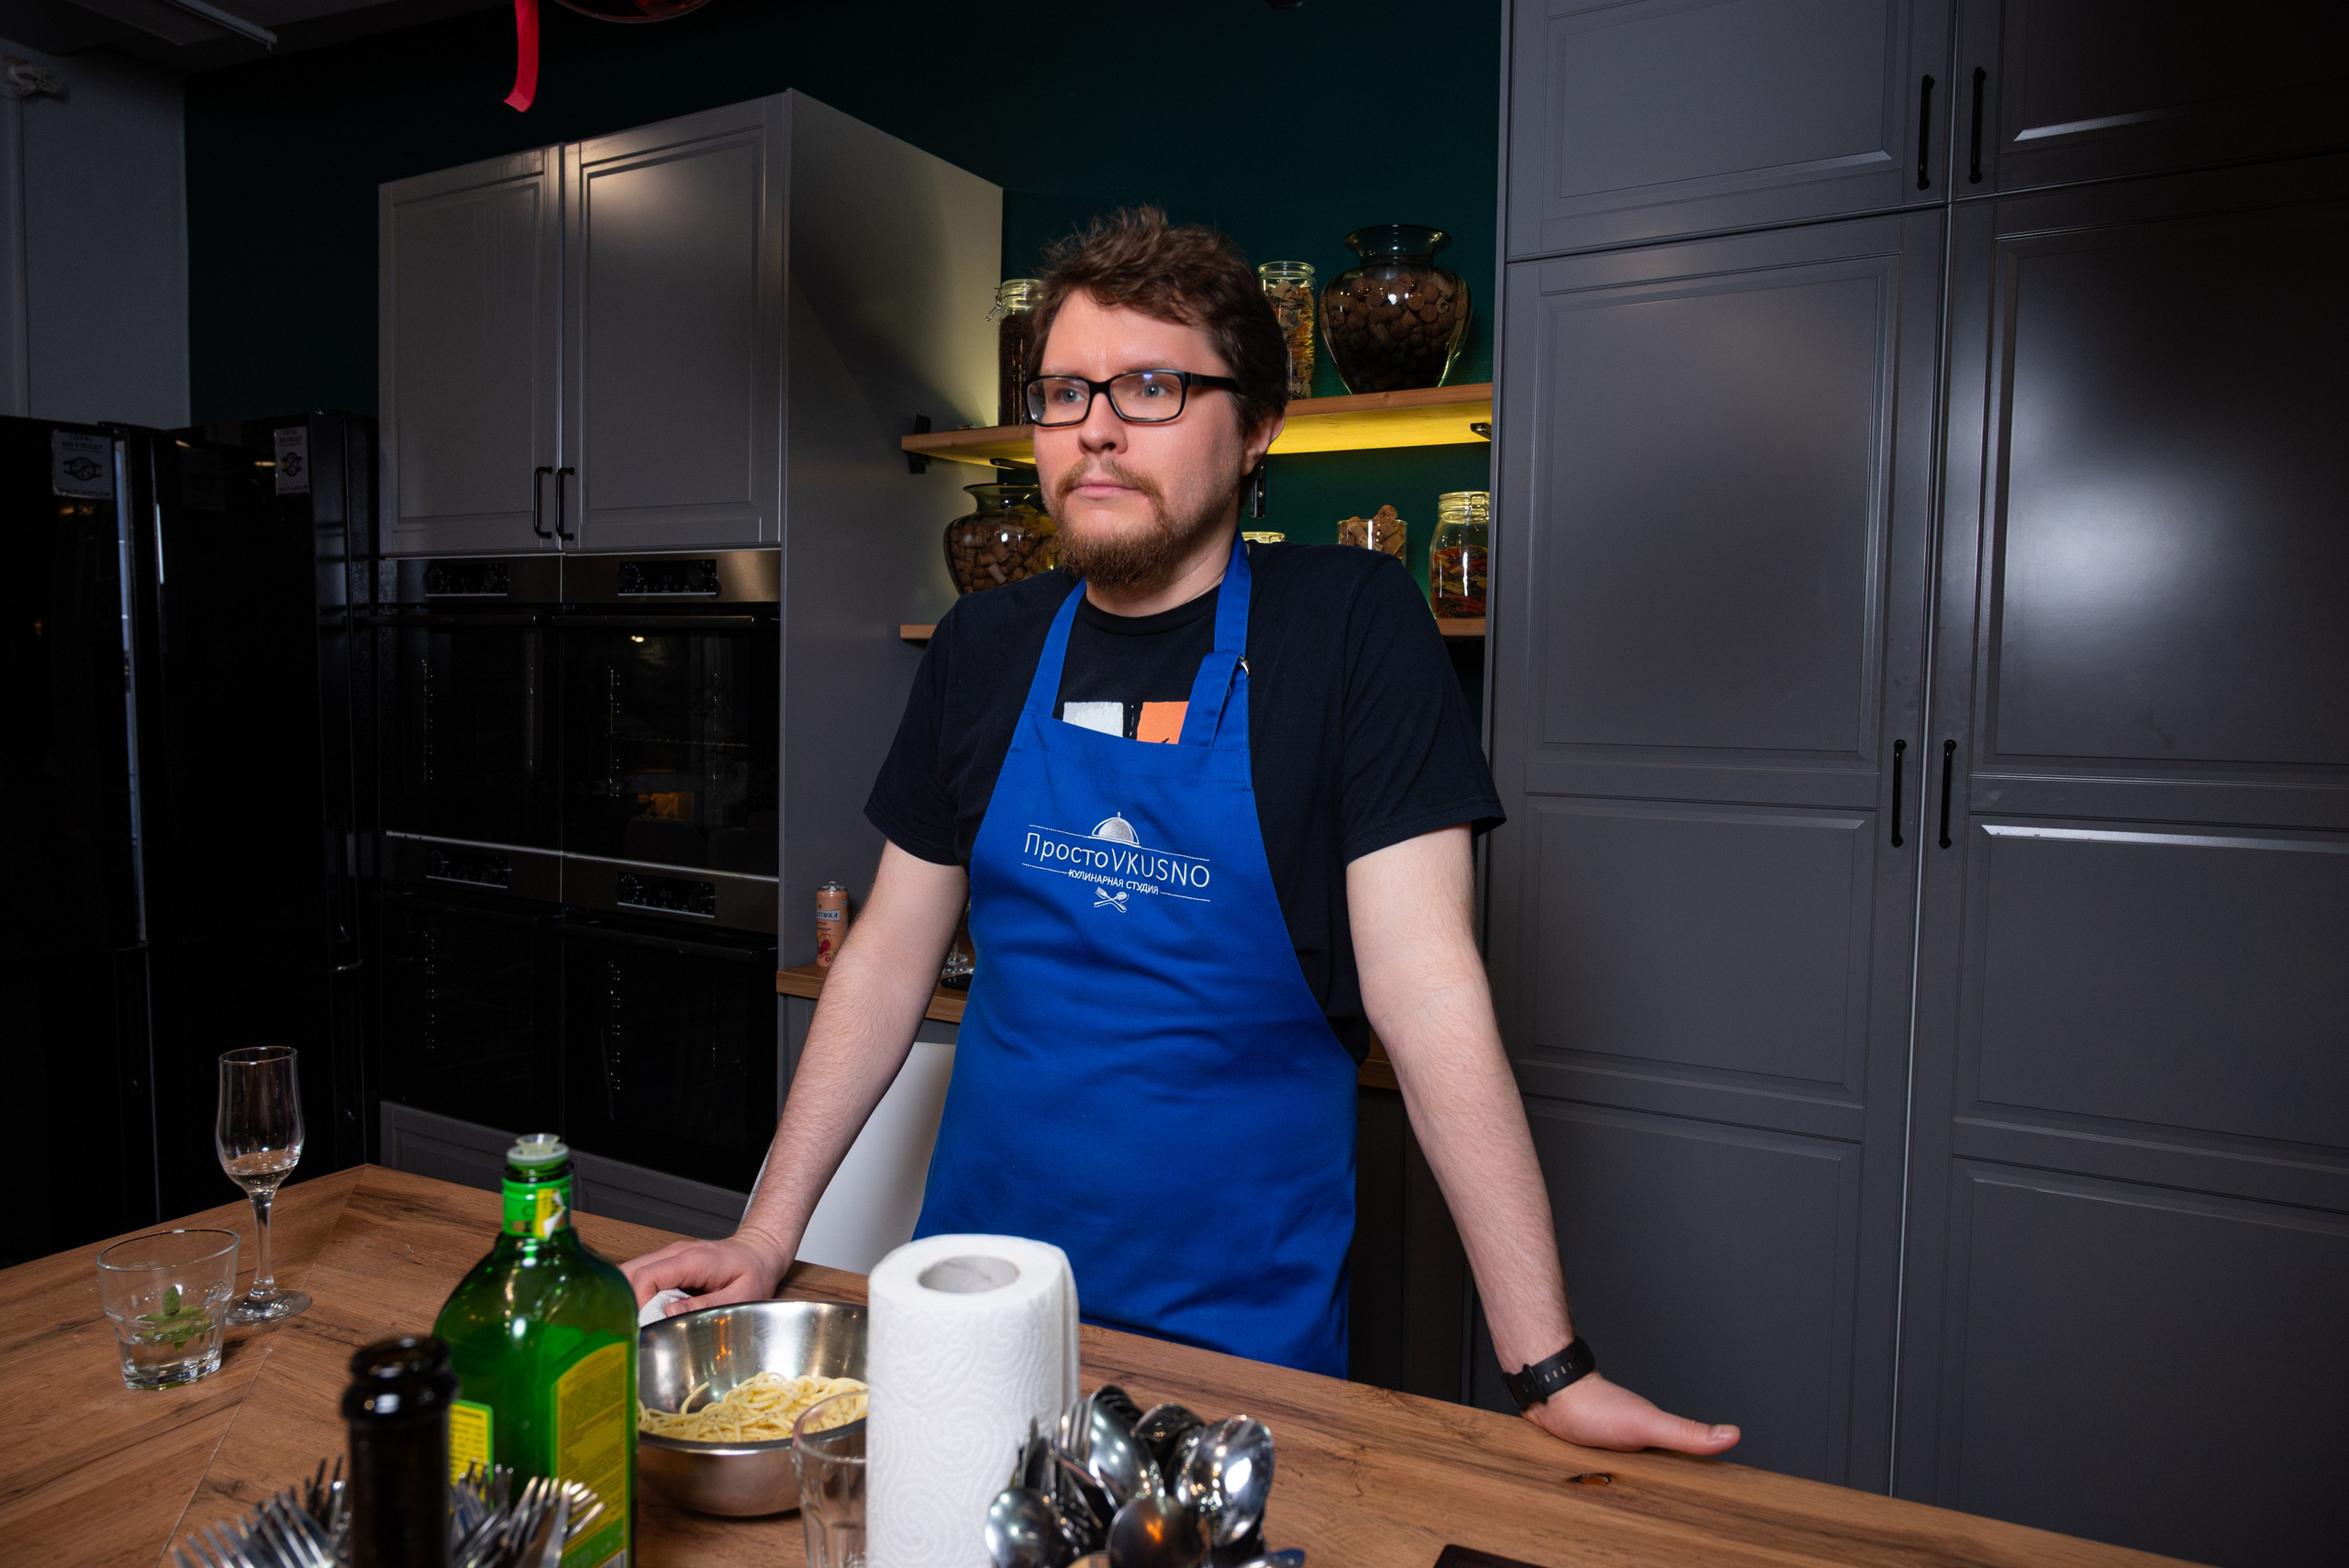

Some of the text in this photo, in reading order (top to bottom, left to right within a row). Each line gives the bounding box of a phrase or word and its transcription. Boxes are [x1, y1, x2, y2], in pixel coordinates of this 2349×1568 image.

[1024, 832, 1209, 888] ПростоVKUSNO
[1069, 868, 1159, 895] КУЛИНАРНАЯ СТУДИЯ
